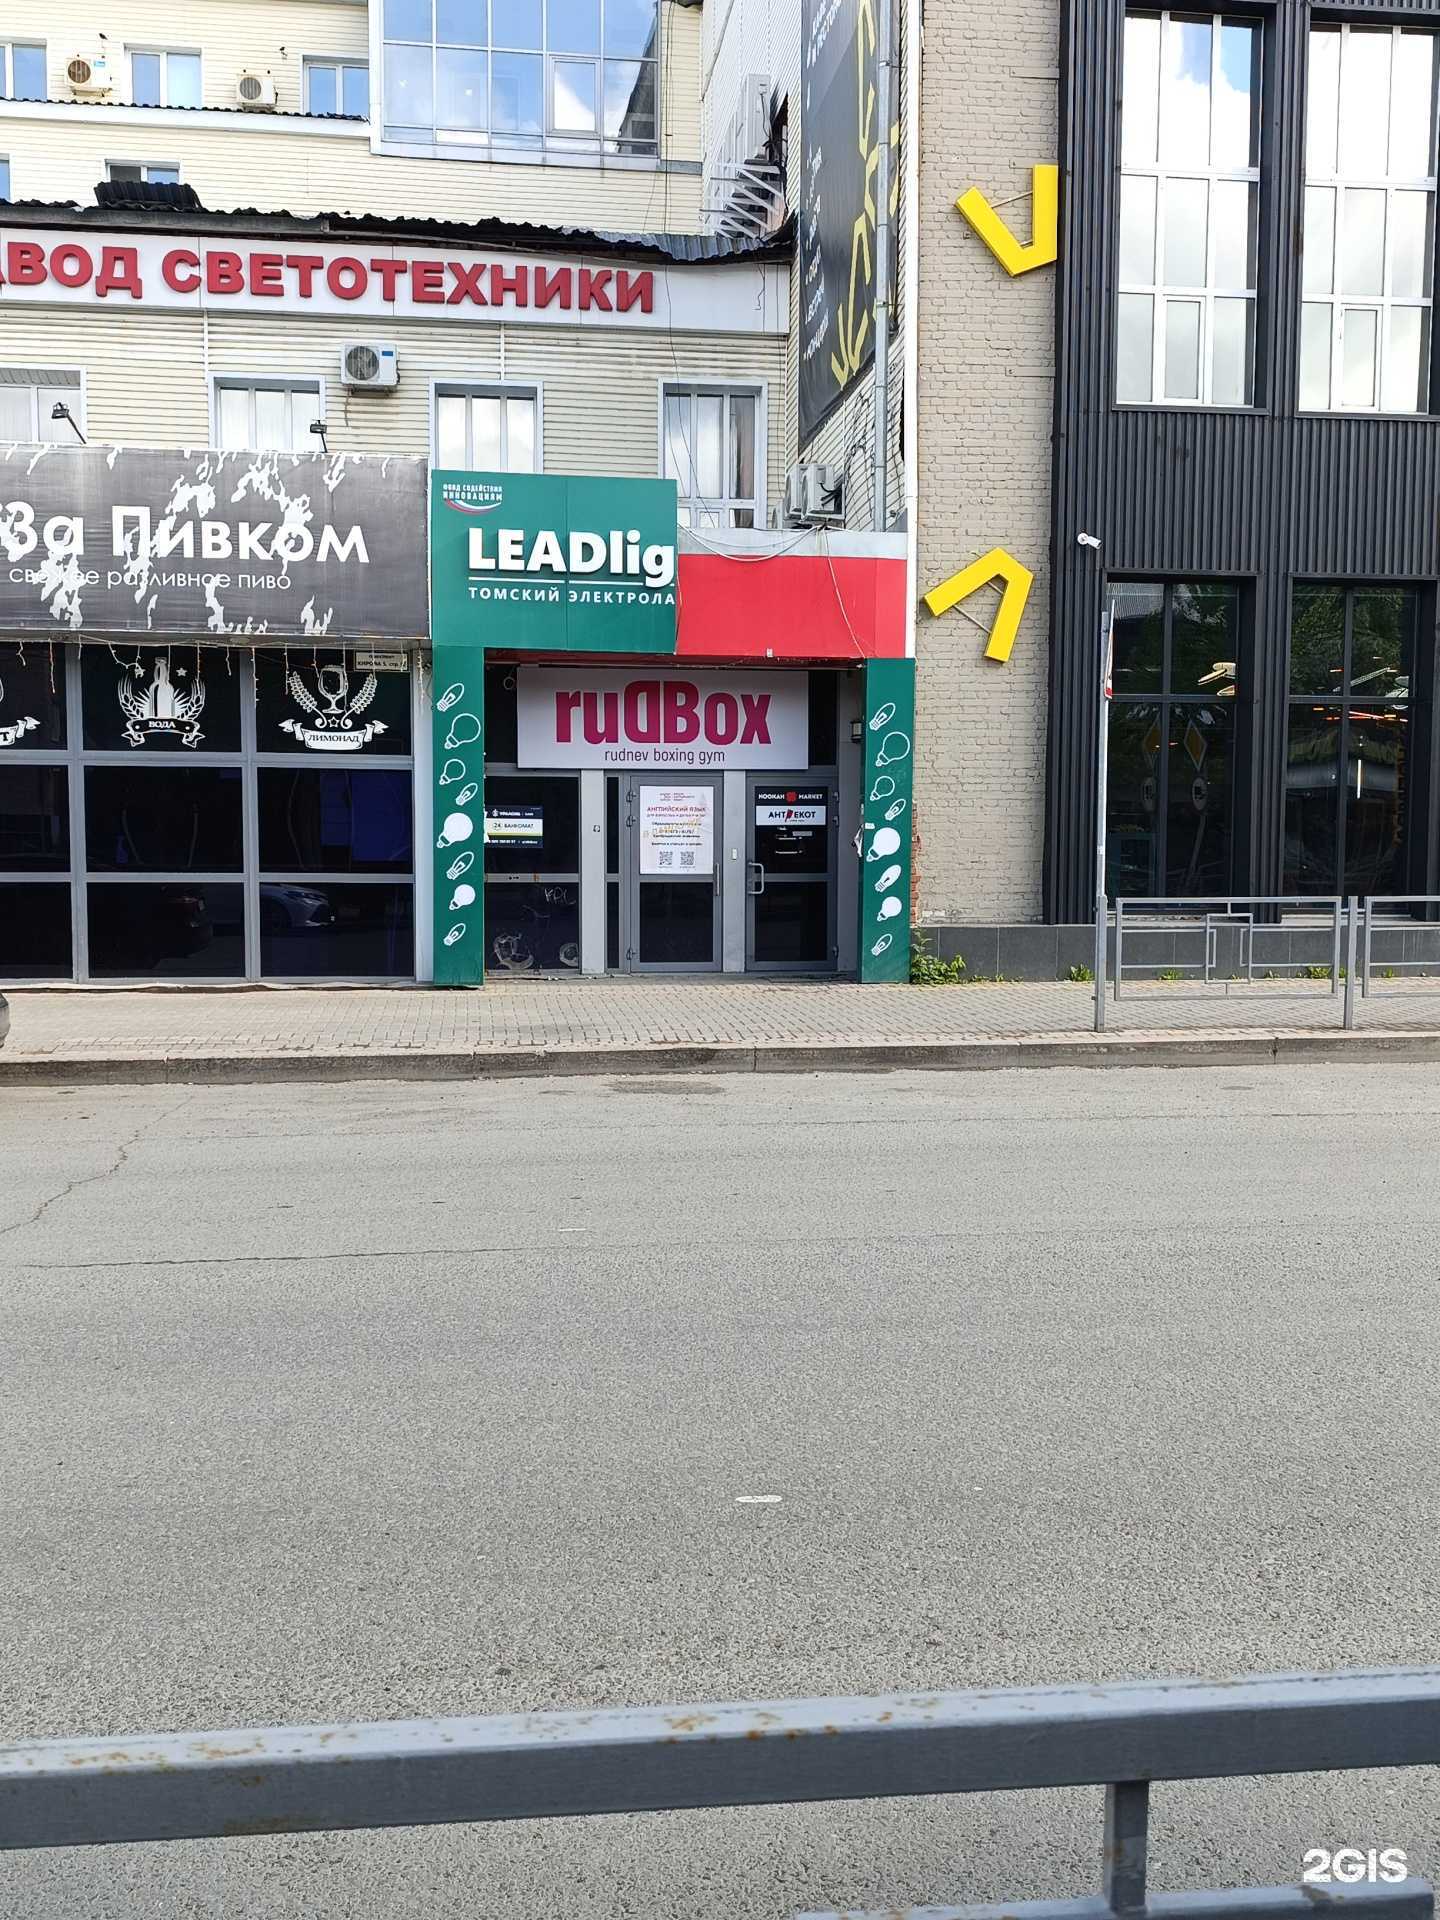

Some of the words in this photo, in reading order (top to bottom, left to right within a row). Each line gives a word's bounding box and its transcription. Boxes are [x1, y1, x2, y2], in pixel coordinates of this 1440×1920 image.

[0, 241, 142, 299] ВОД
[161, 249, 654, 313] СВЕТОТЕХНИКИ
[111, 505, 370, 563] Пивком
[468, 527, 675, 588] LEADlig
[238, 573, 292, 590] пиво
[468, 586, 560, 602] ТОМСКИЙ
[568, 590, 676, 605] ЭЛЕКТРОЛА
[149, 720, 176, 729] ВОДА
[308, 733, 360, 743] ЛИМОНАД
[604, 748, 649, 762] rudnev
[653, 748, 695, 765] boxing
[698, 751, 726, 765] gym
